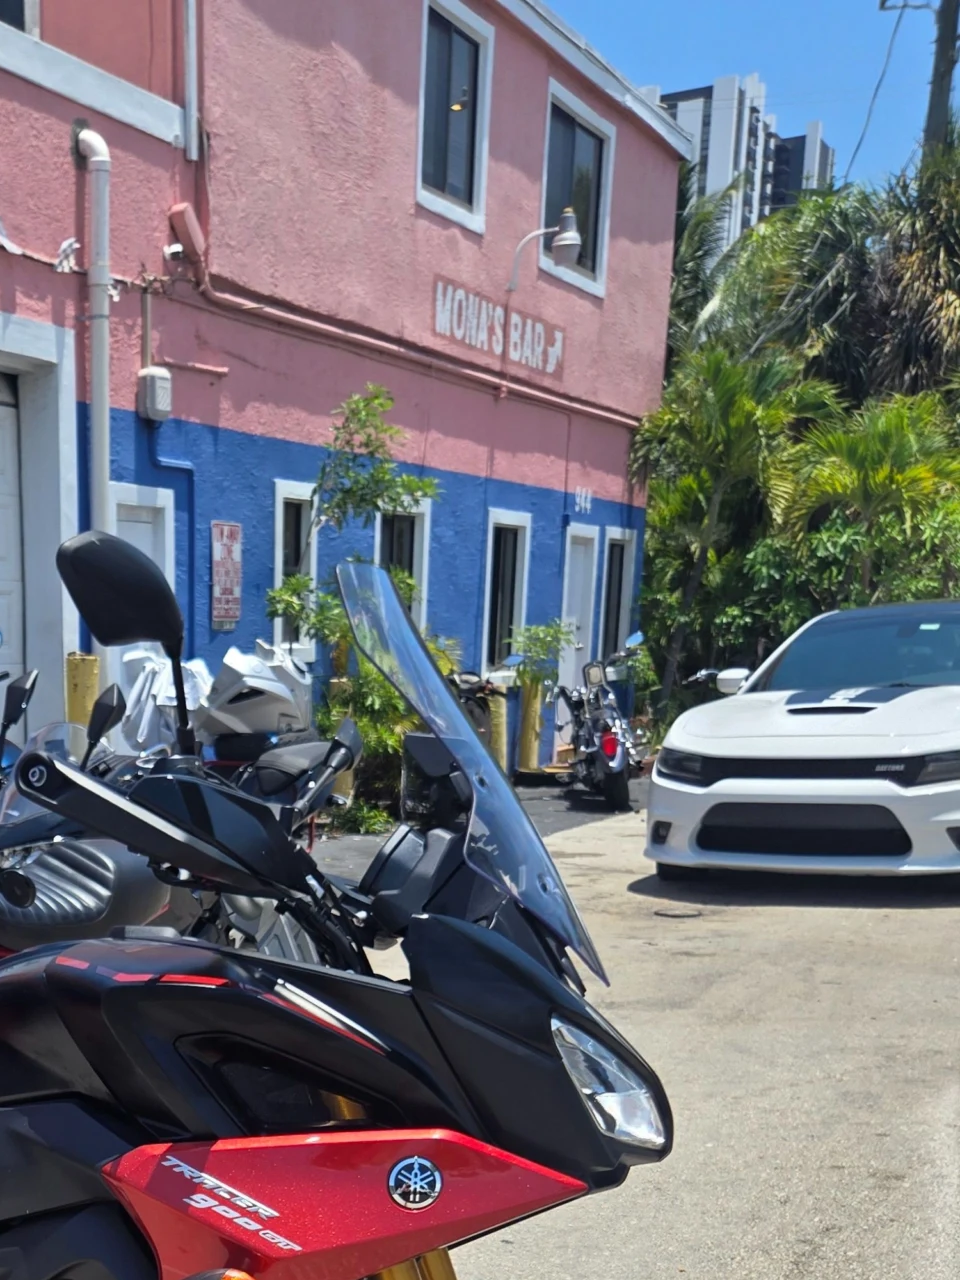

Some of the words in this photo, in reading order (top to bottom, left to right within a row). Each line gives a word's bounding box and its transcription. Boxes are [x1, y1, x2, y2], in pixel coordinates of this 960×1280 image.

[435, 281, 505, 355] MONA'S
[509, 312, 545, 370] BAR
[161, 1155, 280, 1220] TRACER
